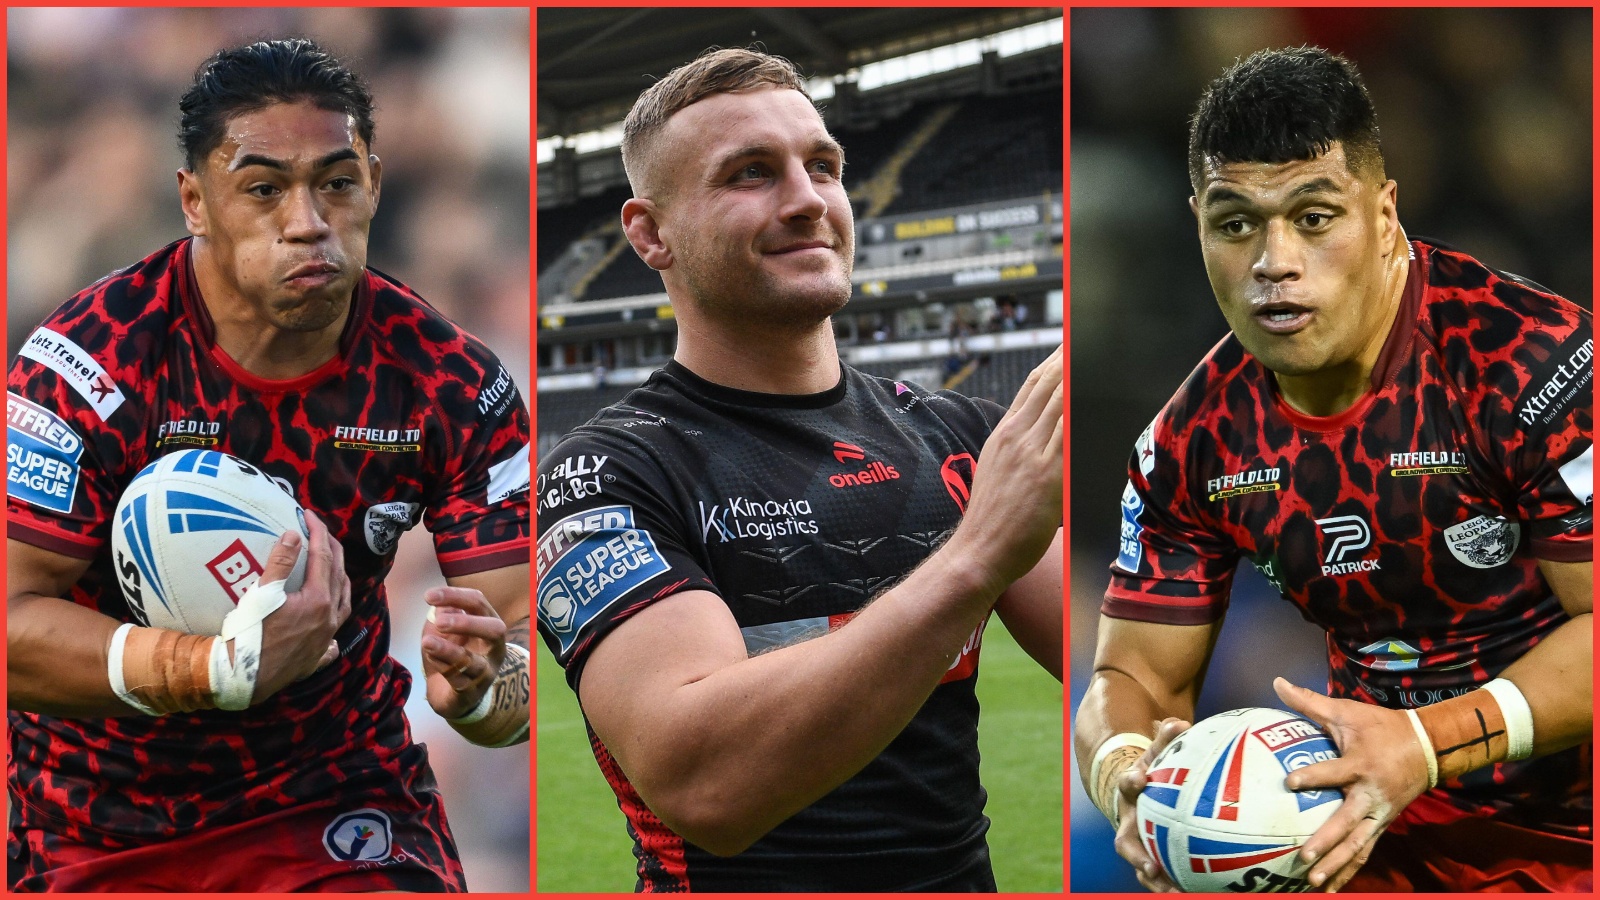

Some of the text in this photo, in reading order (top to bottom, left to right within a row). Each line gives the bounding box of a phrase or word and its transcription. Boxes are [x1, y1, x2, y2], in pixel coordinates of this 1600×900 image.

[31, 334, 97, 381] Jetz Travel
[1518, 338, 1593, 426] iXtract.com
[7, 398, 79, 454] ETFRED
[335, 425, 421, 443] FITFIELD LTD
[7, 443, 73, 483] SUPER
[1390, 451, 1449, 467] FITFIELD
[7, 465, 69, 498] EAGUE
[1256, 467, 1281, 482] LTD
[369, 511, 411, 520] LEOPAR
[384, 504, 406, 512] LEIGH
[729, 496, 812, 517] Kinaxia
[735, 517, 819, 540] Logistics
[1448, 520, 1499, 543] LEOPAR
[537, 511, 627, 577] ETFRED
[565, 529, 646, 590] SUPER
[1322, 558, 1381, 577] PATRICK
[576, 547, 655, 606] LEAGUE
